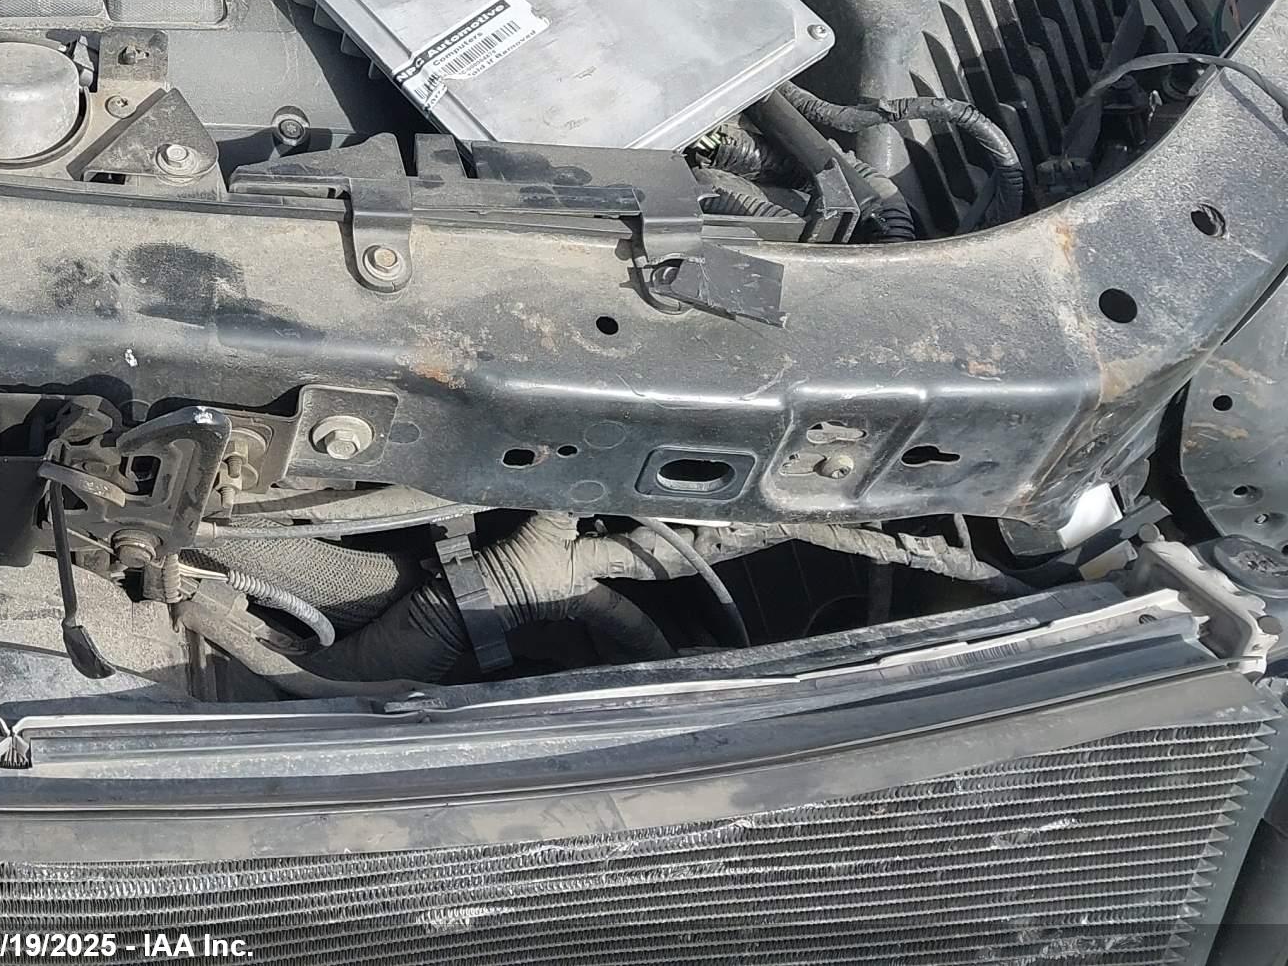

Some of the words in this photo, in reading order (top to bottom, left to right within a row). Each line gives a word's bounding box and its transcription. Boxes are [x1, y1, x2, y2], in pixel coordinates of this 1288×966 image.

[396, 57, 425, 83] NPC
[427, 3, 505, 59] Automotive
[432, 32, 484, 67] Computers
[495, 29, 537, 59] Removed
